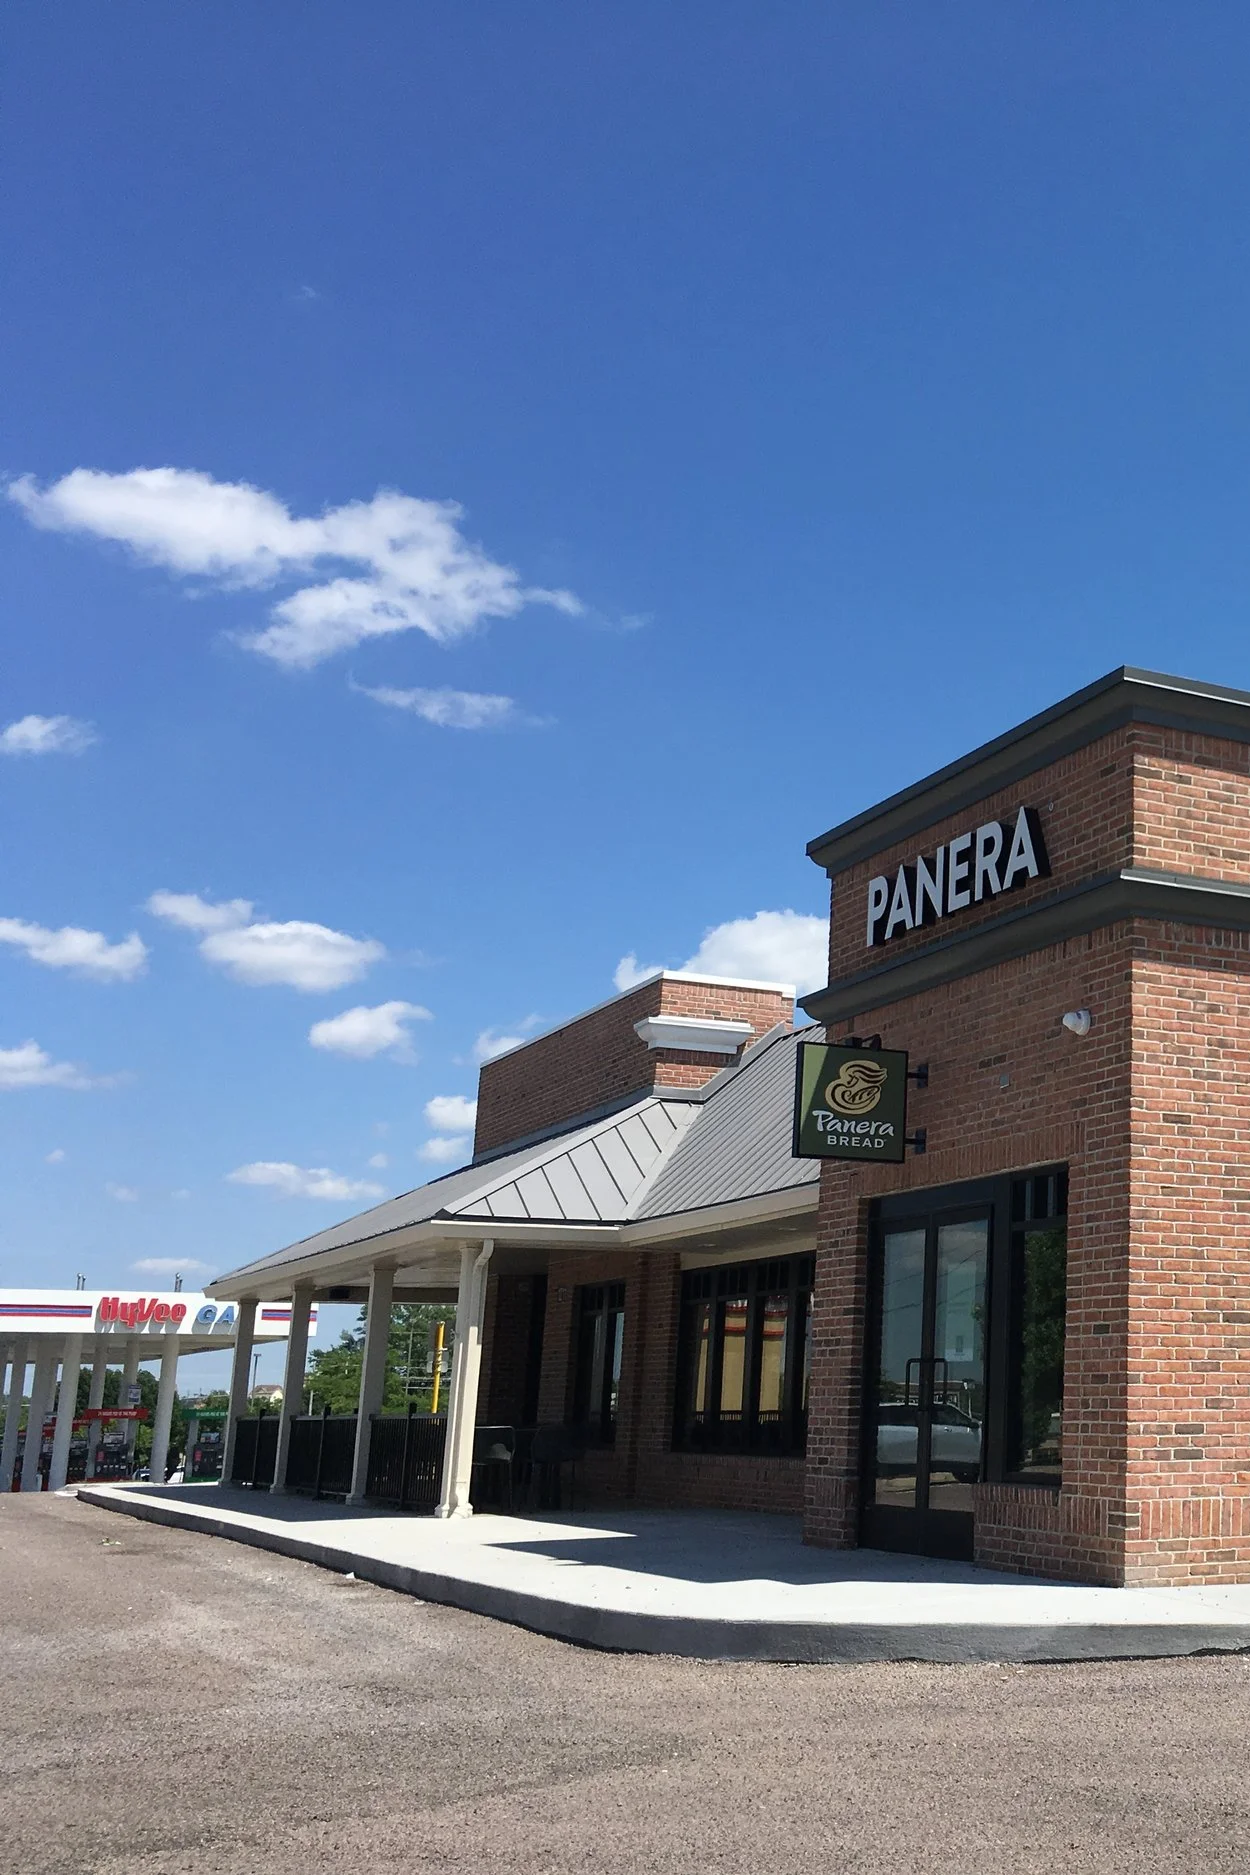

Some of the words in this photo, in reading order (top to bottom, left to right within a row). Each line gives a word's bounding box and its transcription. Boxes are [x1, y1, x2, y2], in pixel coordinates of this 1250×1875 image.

[866, 806, 1039, 947] PANERA
[812, 1110, 894, 1137] Panera
[827, 1135, 885, 1149] BREAD
[197, 1304, 236, 1325] GA
